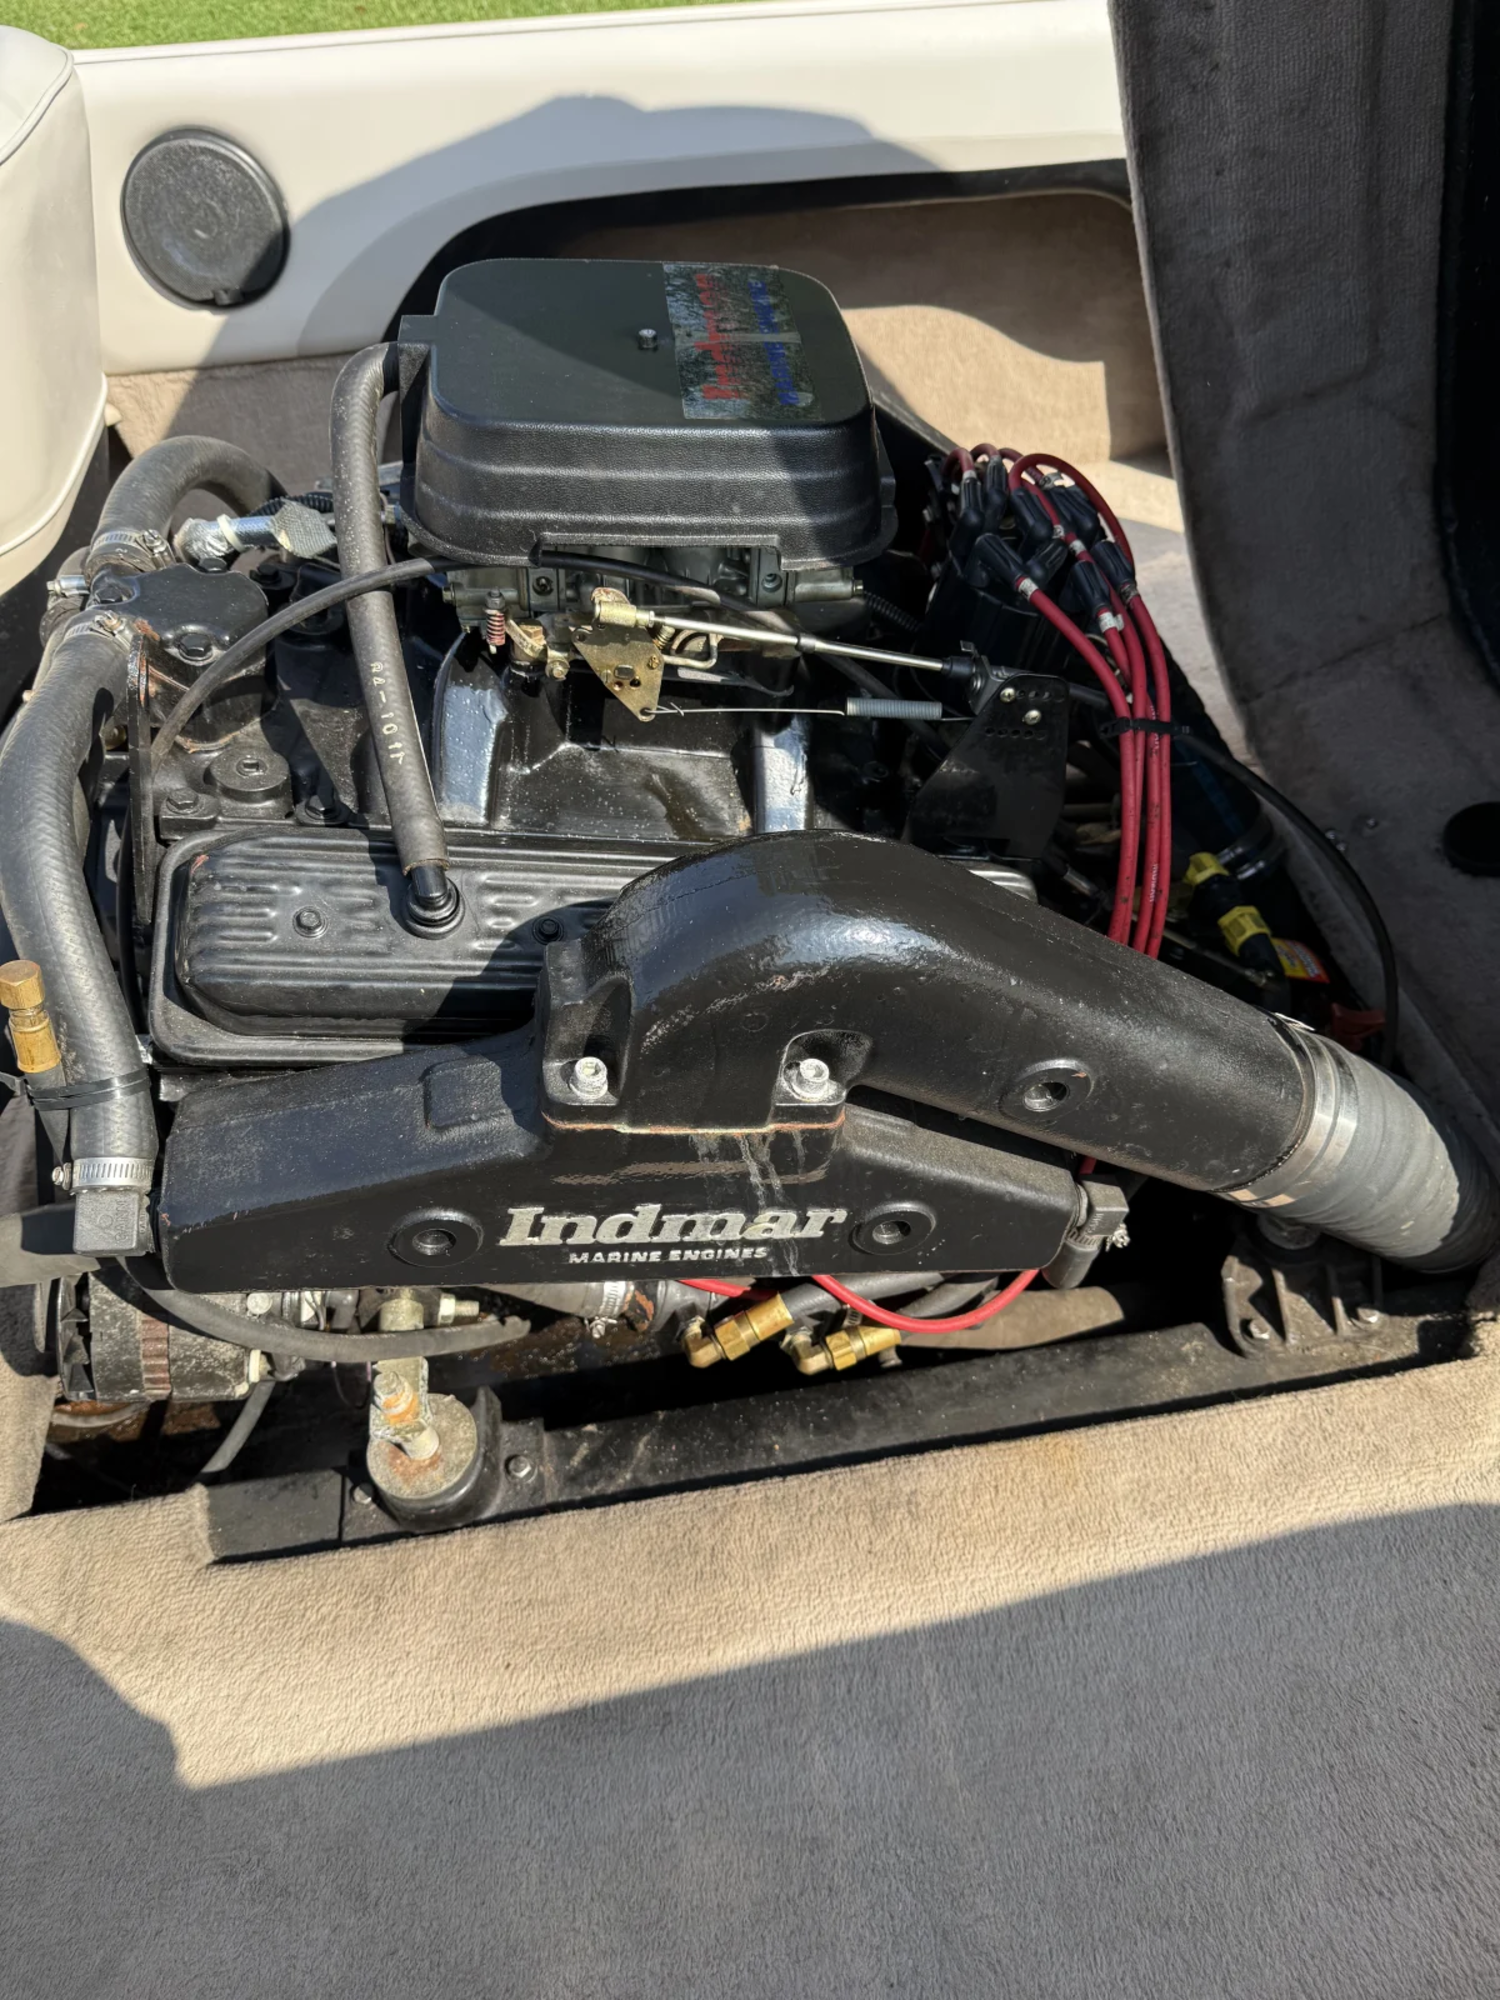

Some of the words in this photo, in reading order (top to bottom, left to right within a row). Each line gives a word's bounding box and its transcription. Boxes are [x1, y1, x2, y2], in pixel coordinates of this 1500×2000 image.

[499, 1203, 848, 1246] Indmar
[568, 1251, 662, 1264] MARINE
[668, 1246, 768, 1261] ENGINES
